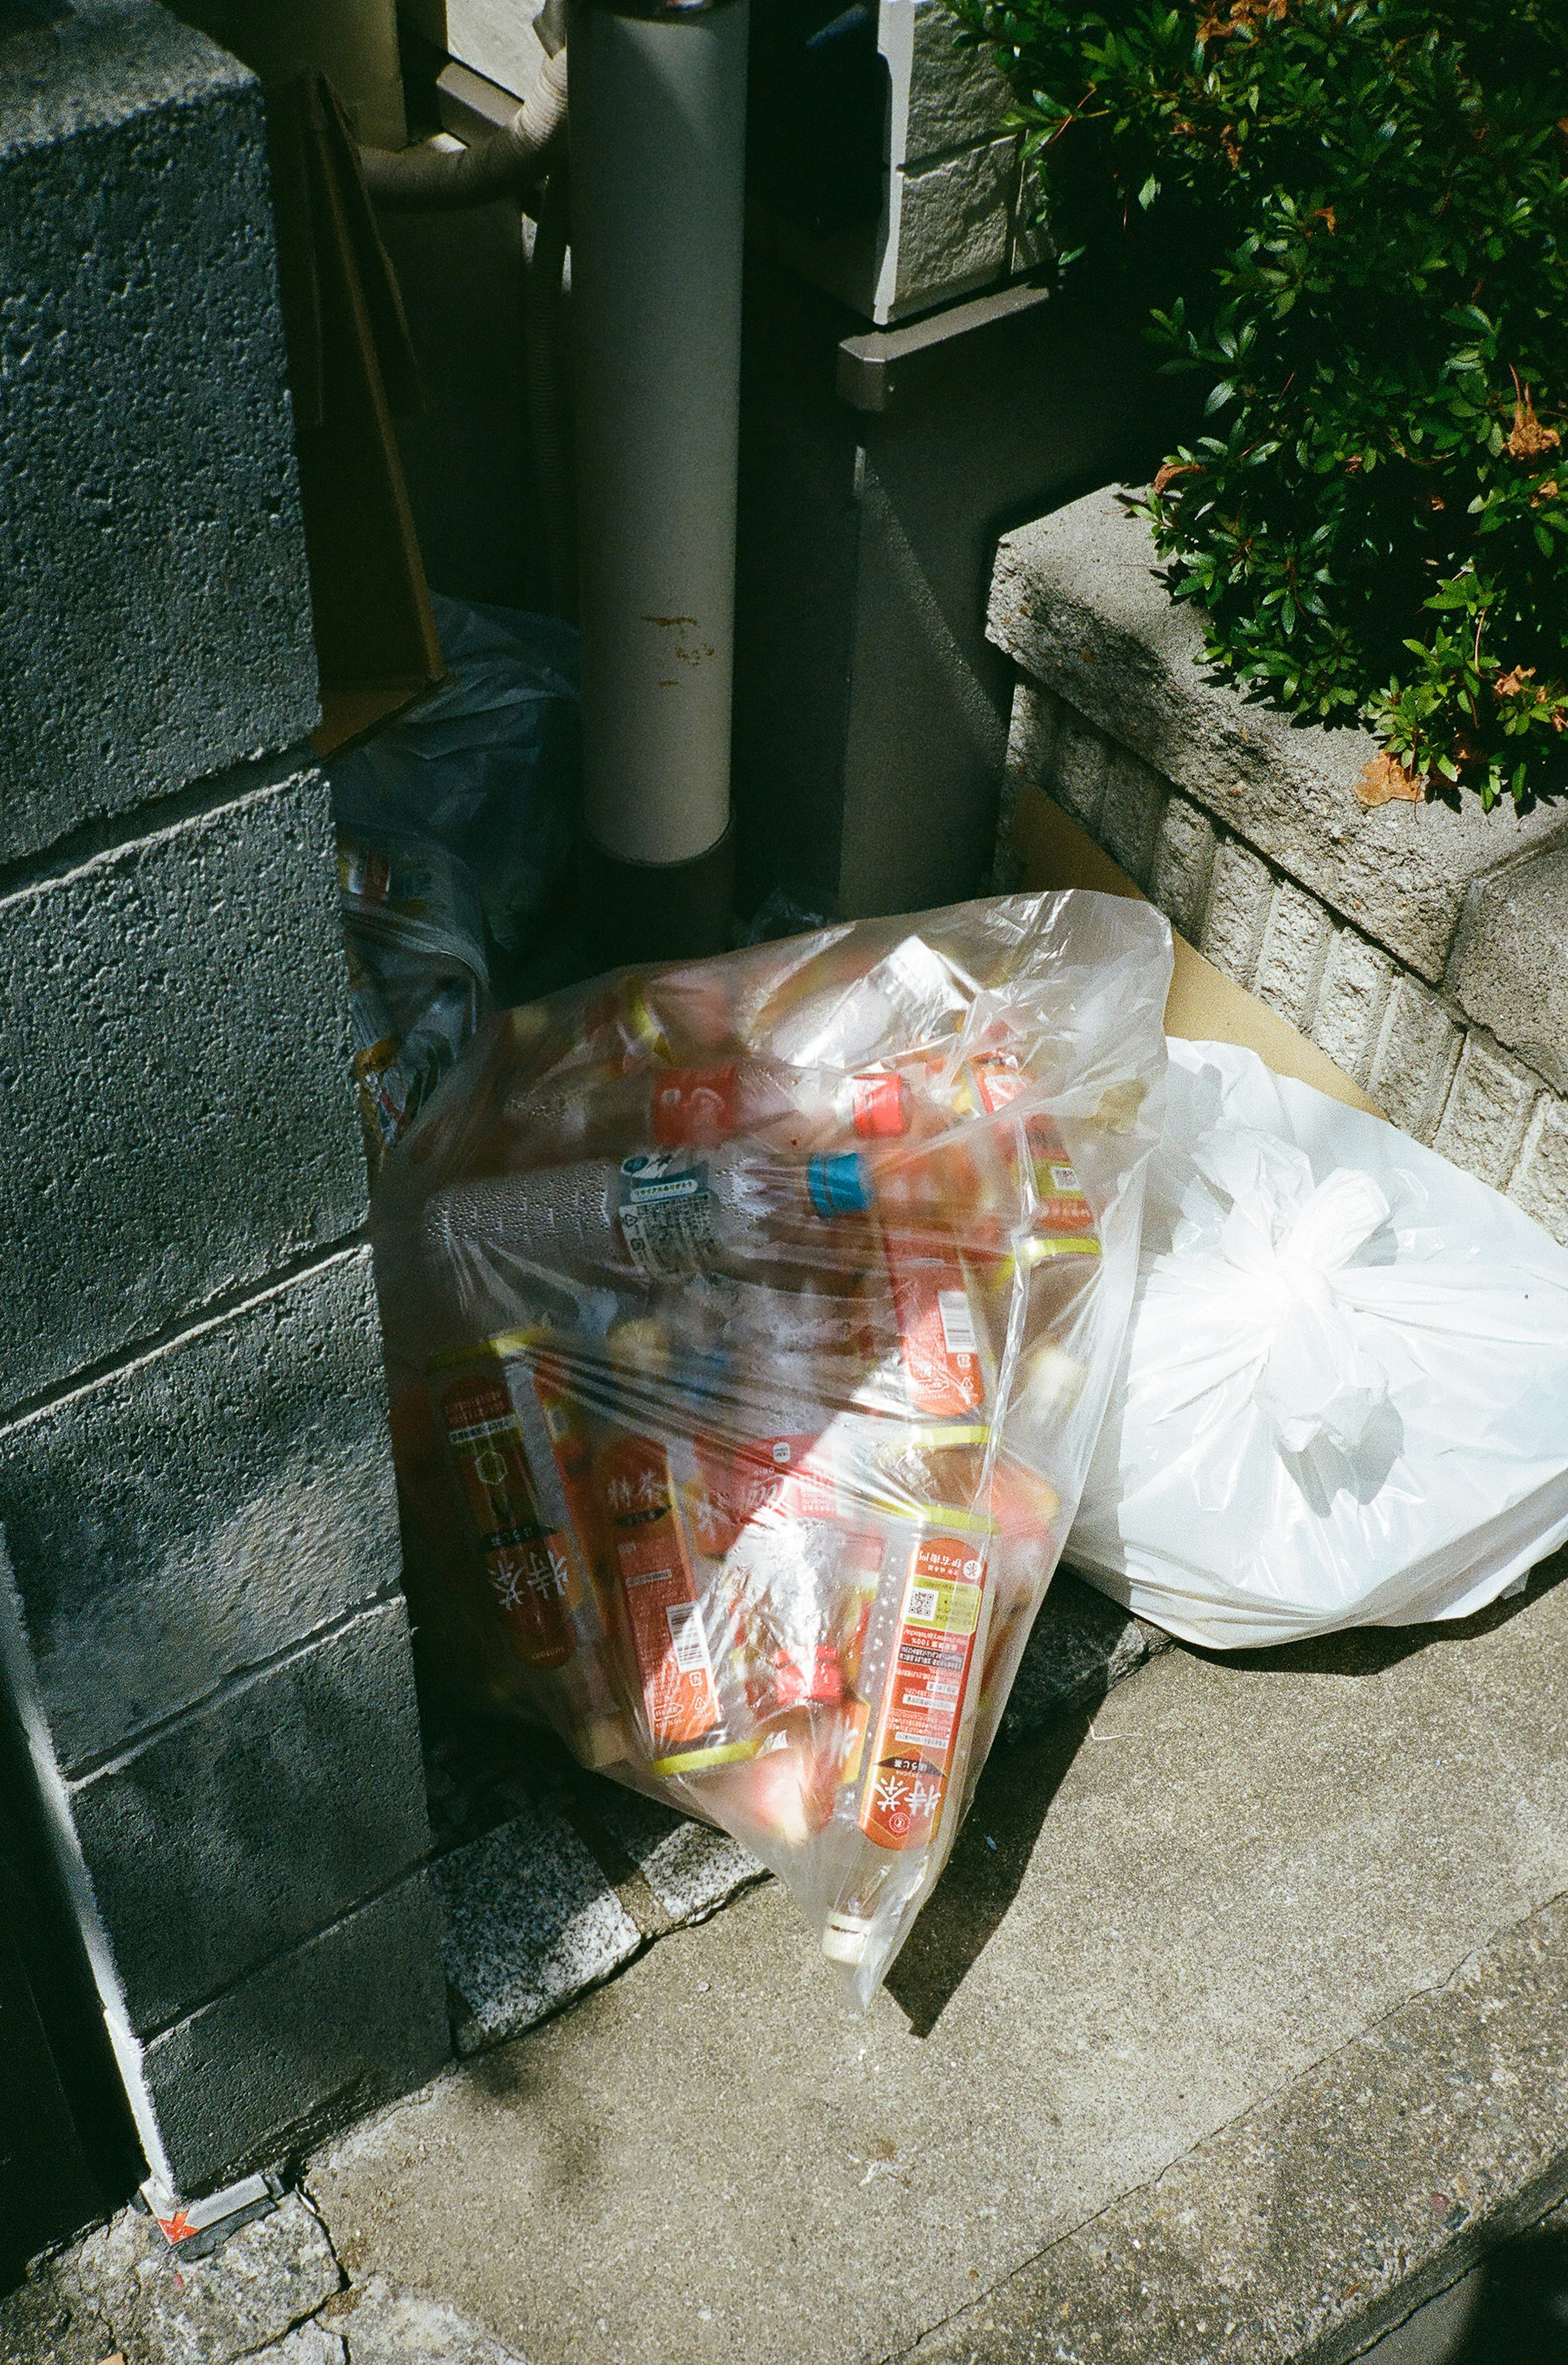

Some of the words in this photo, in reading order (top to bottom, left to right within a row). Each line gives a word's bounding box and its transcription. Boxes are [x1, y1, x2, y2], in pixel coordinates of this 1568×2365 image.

[918, 1552, 961, 1567] 伊右衛門
[488, 1549, 568, 1611] 特茶
[911, 1637, 930, 1646] 100%
[870, 1775, 941, 1817] 特茶
